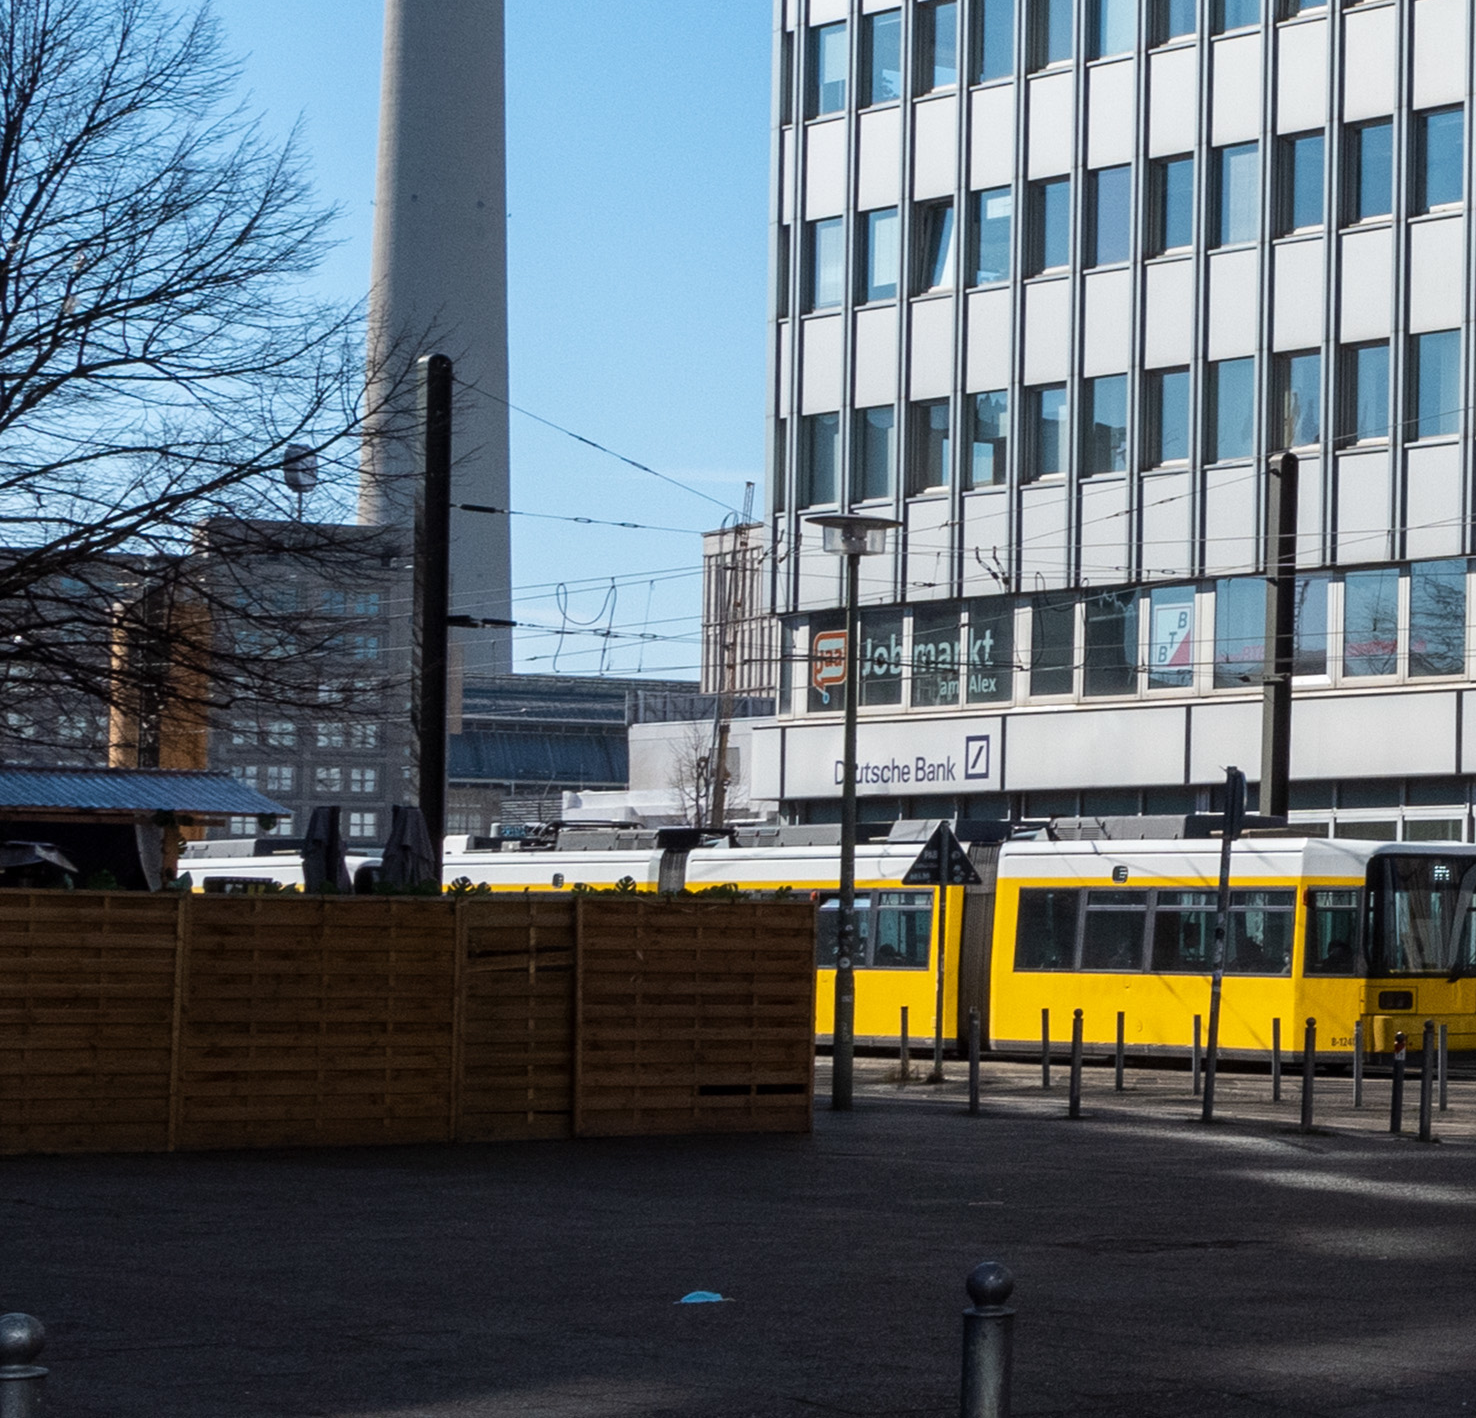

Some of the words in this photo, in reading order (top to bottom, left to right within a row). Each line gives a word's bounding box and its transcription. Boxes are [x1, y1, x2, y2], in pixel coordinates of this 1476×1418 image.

[969, 674, 997, 694] Alex
[834, 757, 911, 785] Dutsche
[914, 755, 956, 782] Bank
